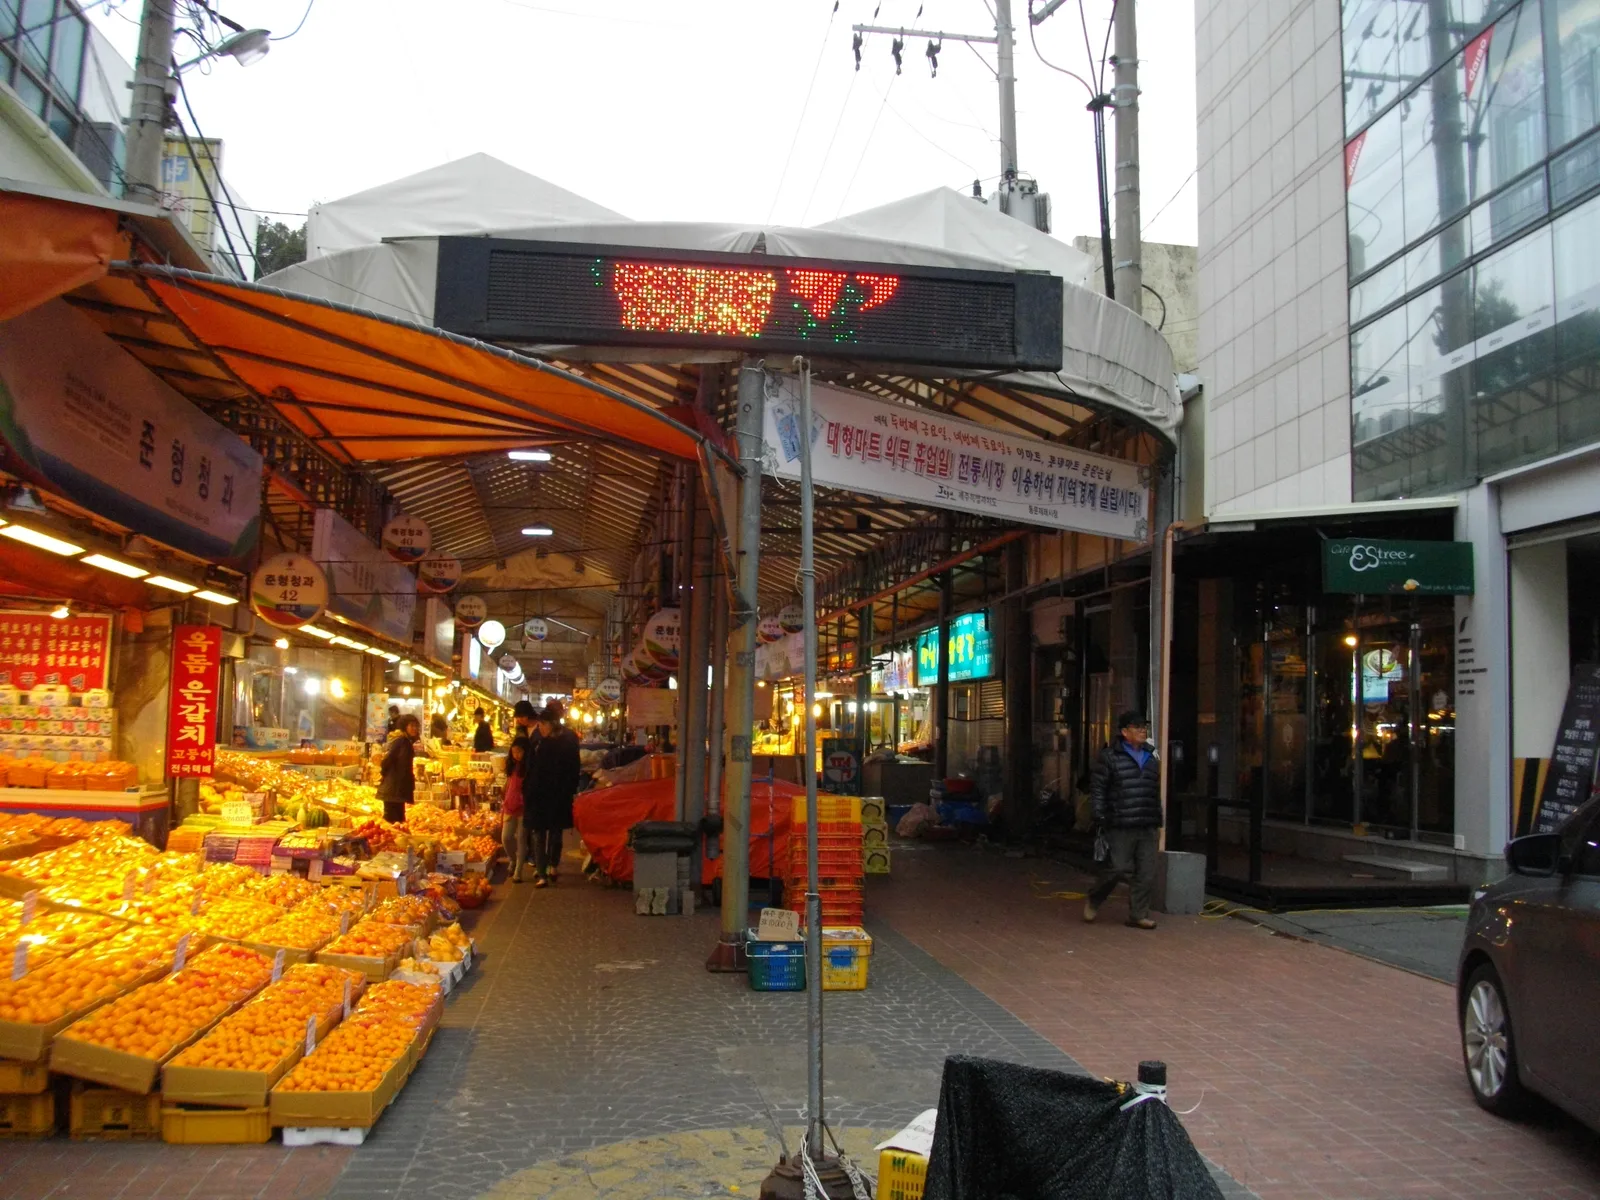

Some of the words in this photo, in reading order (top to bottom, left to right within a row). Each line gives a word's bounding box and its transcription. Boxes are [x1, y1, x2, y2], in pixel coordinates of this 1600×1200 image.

[1468, 38, 1487, 82] daiso
[890, 412, 919, 434] 두번째
[952, 430, 980, 447] 네번째
[826, 421, 881, 461] 대형마트
[885, 435, 911, 469] 의무
[914, 441, 955, 477] 휴업일!
[957, 452, 1006, 491] 전통시장
[1011, 466, 1054, 501] 이용하여
[1056, 475, 1098, 511] 지역경제
[1099, 485, 1143, 517] 살립시다!
[265, 574, 315, 587] 준형청과
[279, 589, 298, 601] 42
[181, 631, 215, 675] 옥돔
[176, 679, 213, 746] 은갈치
